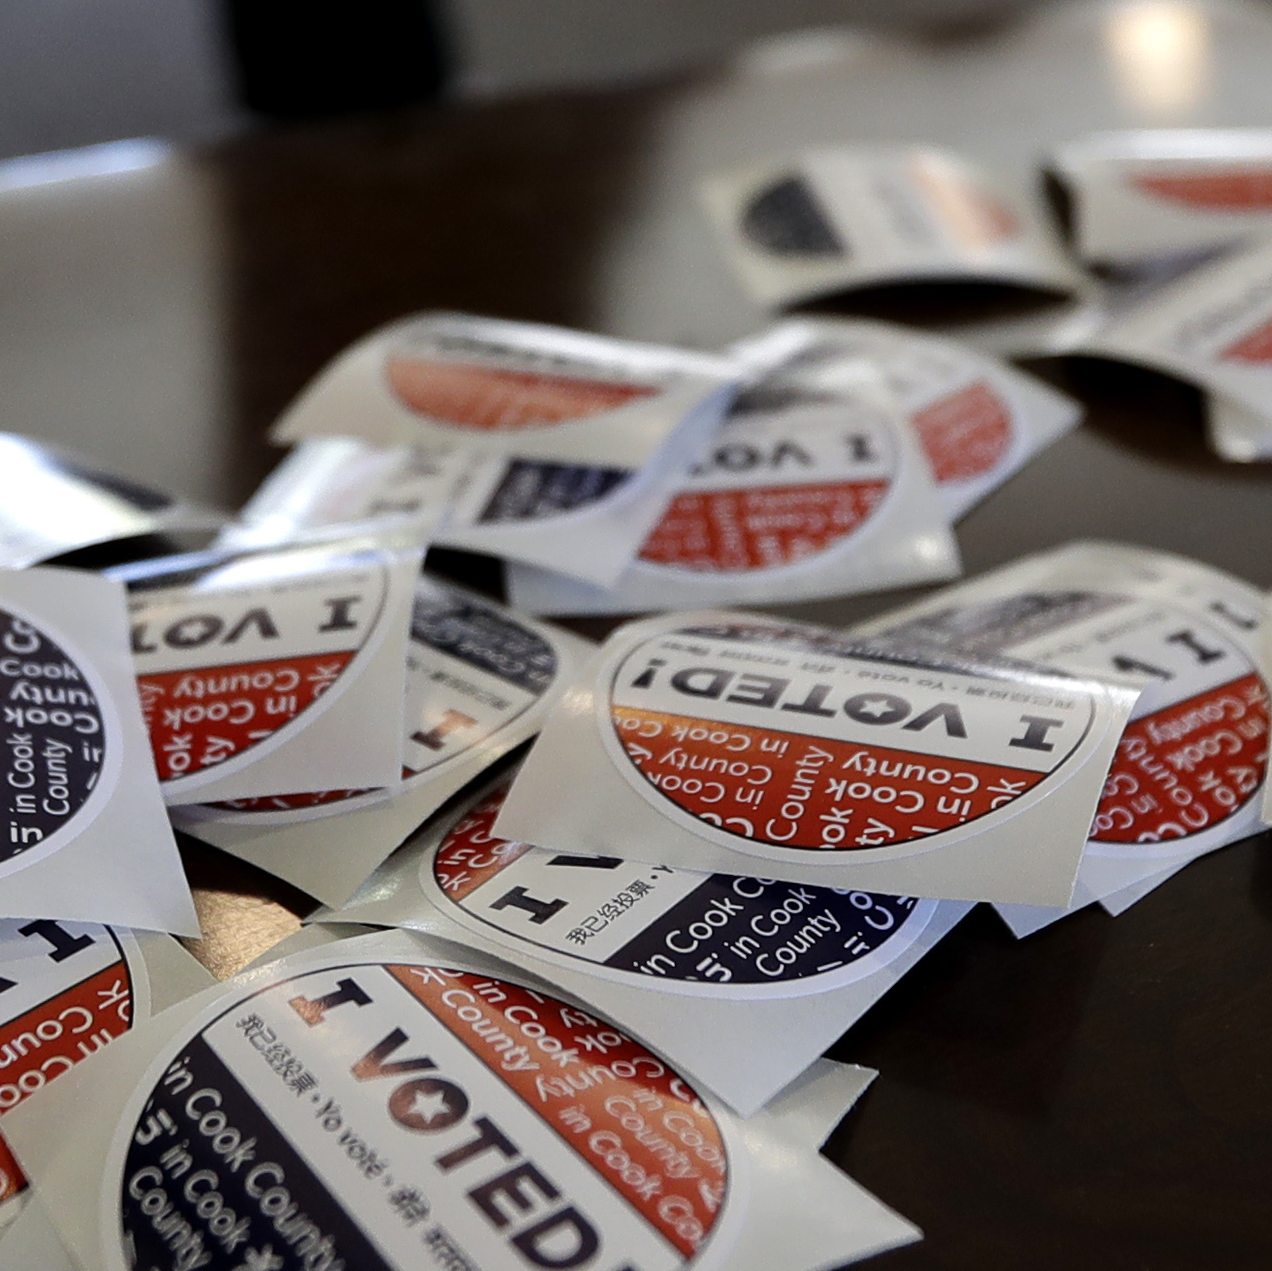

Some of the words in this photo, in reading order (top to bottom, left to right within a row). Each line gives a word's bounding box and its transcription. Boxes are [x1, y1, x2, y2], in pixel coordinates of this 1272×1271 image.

[318, 595, 362, 634] I
[1165, 631, 1225, 664] I
[0, 659, 79, 680] Cook
[172, 668, 300, 698] County
[164, 700, 255, 730] Cook
[266, 695, 297, 717] in
[630, 658, 968, 739] VOTED!
[4, 707, 99, 734] Cook
[410, 709, 478, 751] I
[672, 725, 751, 751] Cook
[1008, 714, 1064, 752] I
[7, 733, 36, 787] Cook
[660, 748, 772, 785] County
[760, 738, 790, 758] in
[1167, 731, 1243, 771] Cook
[42, 738, 72, 815] County
[766, 746, 834, 841] County
[842, 751, 980, 794] County
[10, 787, 36, 813] in
[735, 787, 764, 810] in
[825, 778, 925, 814] Cook
[936, 795, 972, 822] in
[489, 886, 570, 925] I
[566, 879, 655, 946] 我已经投票
[724, 936, 760, 960] in
[750, 887, 818, 939] Cook
[17, 919, 96, 963] I
[633, 950, 676, 976] in
[666, 895, 745, 955] Cook
[755, 908, 842, 977] County
[695, 953, 732, 982] in
[288, 977, 374, 1027] I
[473, 980, 507, 1004] in
[504, 1005, 579, 1067] Cook
[442, 990, 540, 1071] County
[235, 1012, 318, 1097] 我已经投票
[536, 1056, 665, 1102] County
[633, 1086, 666, 1111] in
[315, 1096, 341, 1130] Yo
[338, 1126, 388, 1179] voté
[557, 1105, 592, 1133] in
[589, 1130, 661, 1201] Cook
[605, 1095, 702, 1179] County
[164, 1056, 194, 1095] in
[185, 1087, 257, 1173] Cook
[244, 1161, 346, 1271] County
[129, 1165, 213, 1271] County
[160, 1139, 193, 1179] in
[183, 1169, 252, 1254] Cook
